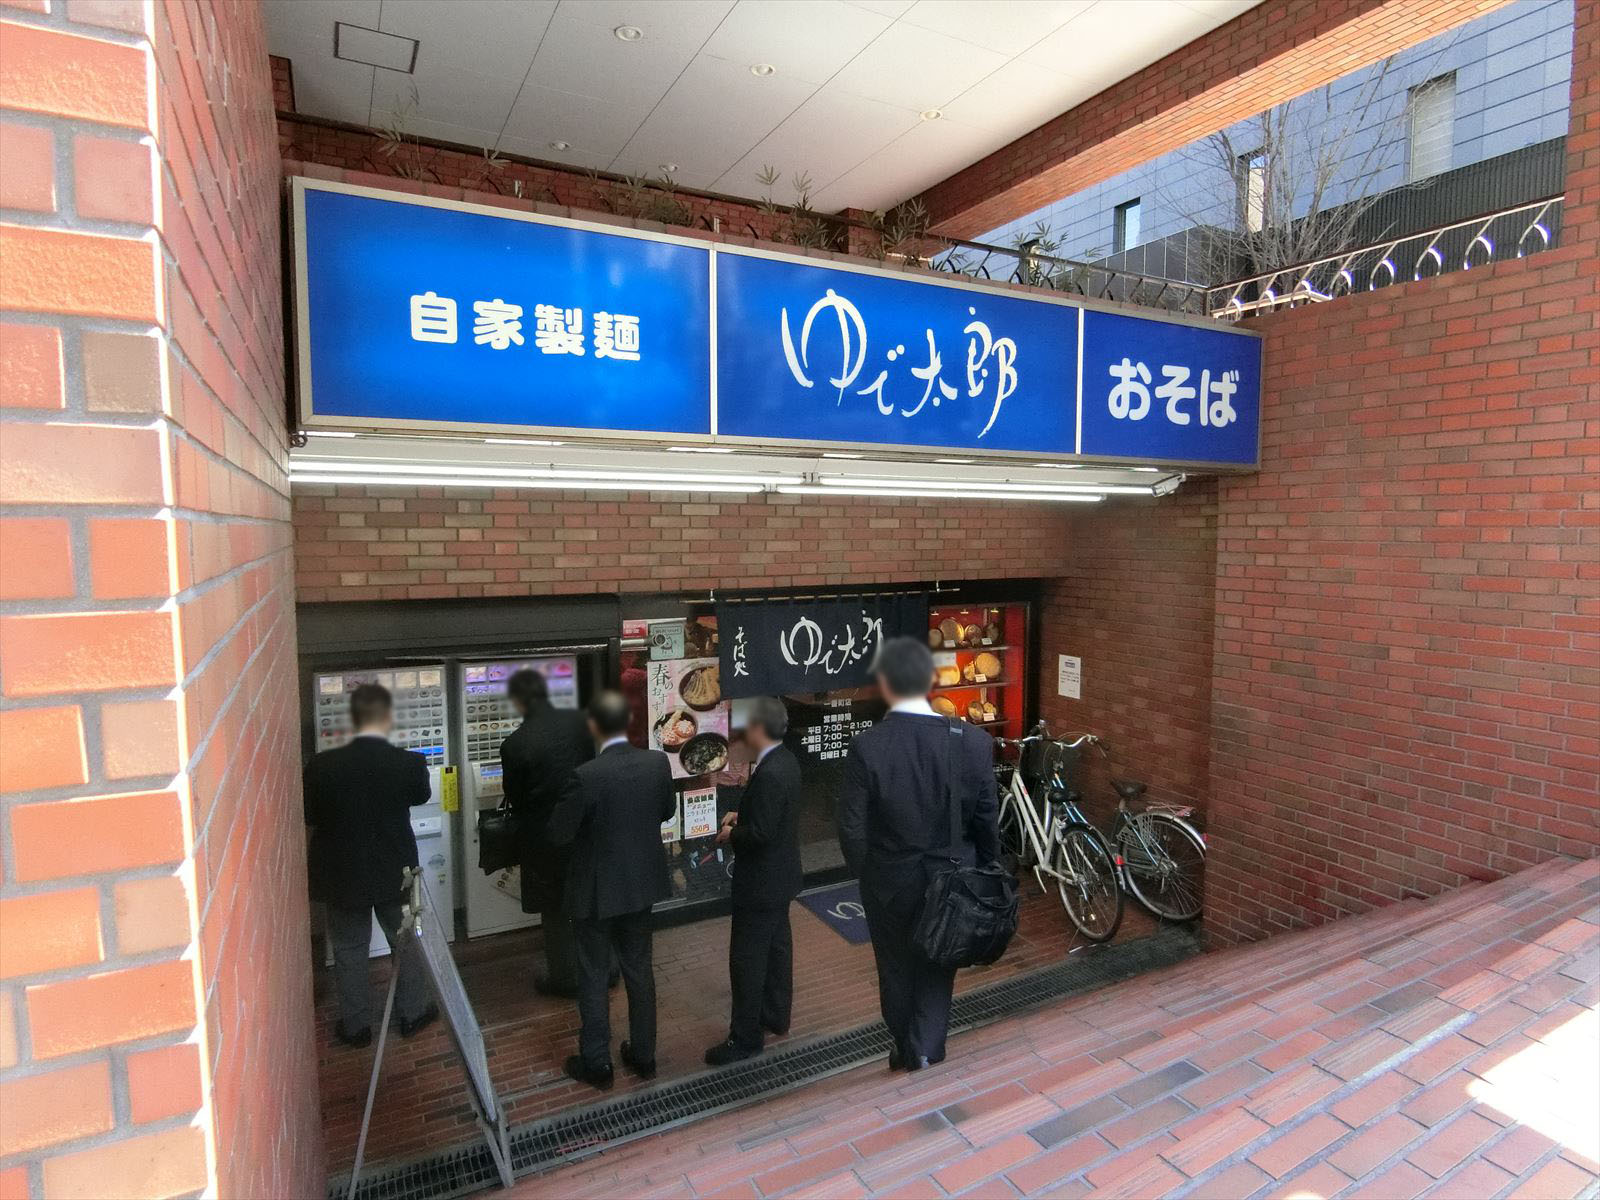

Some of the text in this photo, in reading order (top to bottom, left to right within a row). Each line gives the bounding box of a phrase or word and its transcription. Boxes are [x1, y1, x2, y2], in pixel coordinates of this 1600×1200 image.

[410, 291, 641, 361] 自家製麺
[781, 288, 1018, 439] ゆで太郎
[1108, 357, 1240, 427] おそば
[733, 626, 750, 677] そば処
[808, 726, 821, 734] 平日
[824, 713, 851, 723] 営業時間
[801, 734, 821, 745] 土曜日
[820, 750, 840, 761] 日曜日
